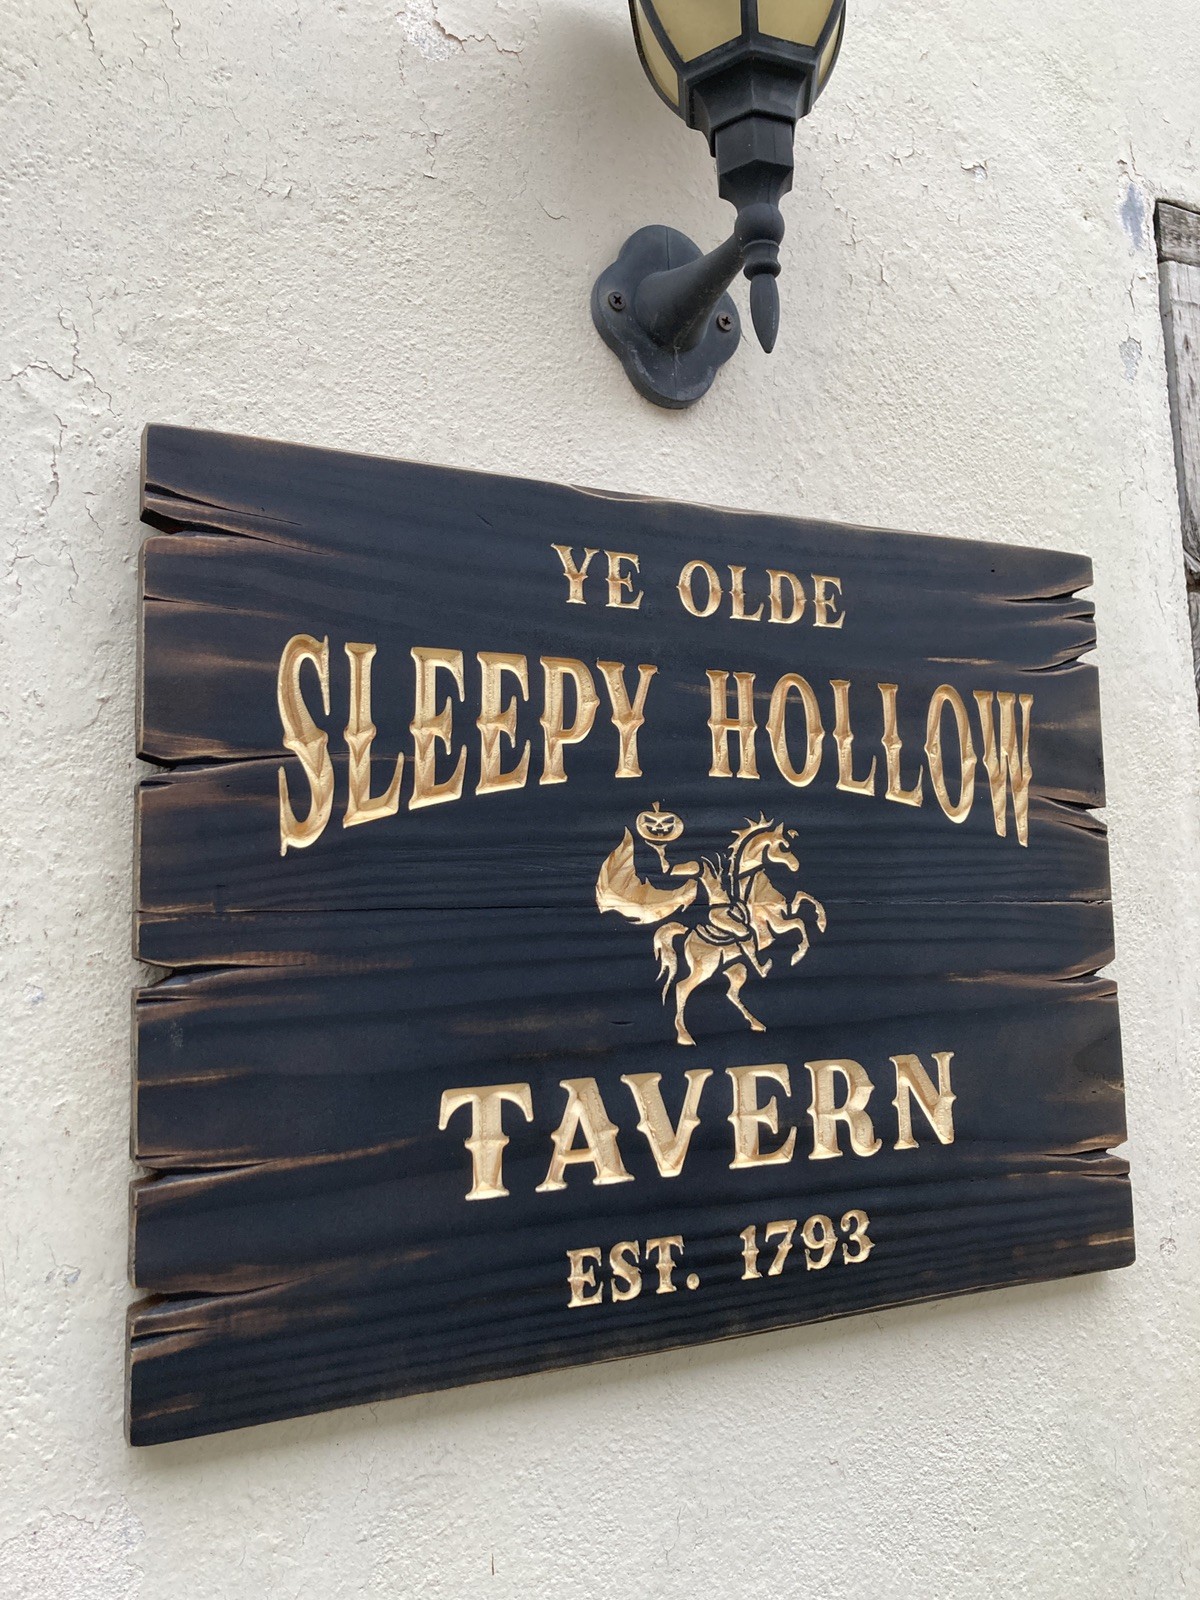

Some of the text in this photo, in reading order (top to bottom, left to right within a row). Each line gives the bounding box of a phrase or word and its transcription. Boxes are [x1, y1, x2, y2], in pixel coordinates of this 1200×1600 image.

[550, 543, 846, 629] YE OLDE
[277, 633, 1034, 857] SLEEPY HOLLOW
[438, 1051, 957, 1201] TAVERN
[566, 1209, 876, 1309] EST. 1793
